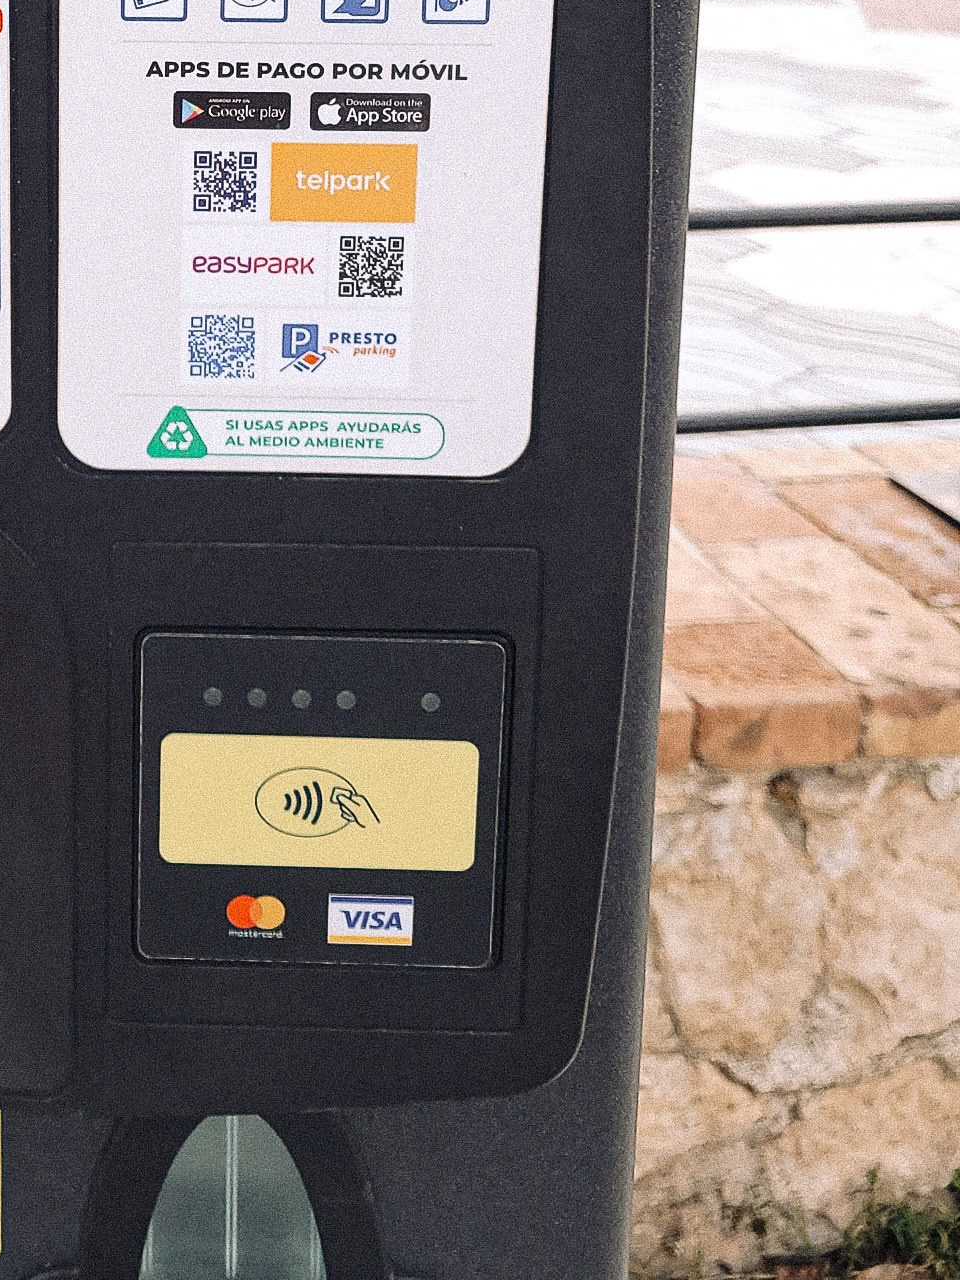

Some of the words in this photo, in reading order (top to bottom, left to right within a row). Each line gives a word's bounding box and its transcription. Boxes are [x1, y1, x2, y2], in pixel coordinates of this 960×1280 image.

[146, 61, 209, 77] APPS
[218, 62, 249, 78] DE
[258, 63, 324, 79] PAGO
[333, 63, 382, 79] POR
[391, 60, 467, 80] MÓVIL
[209, 102, 255, 121] Google
[260, 107, 285, 120] play
[346, 99, 392, 109] Download
[346, 108, 379, 125] App
[383, 108, 422, 122] Store
[297, 171, 390, 195] telpark
[292, 328, 310, 352] P
[330, 332, 397, 344] PRESTO
[353, 343, 396, 358] parking
[226, 420, 238, 430] SI
[244, 420, 283, 430] USAS
[288, 421, 328, 431] APPS
[337, 422, 421, 433] AYUDARÁS
[226, 436, 244, 446] AL
[250, 437, 300, 447] MEDIO
[305, 438, 383, 448] AMBIENTE
[343, 911, 402, 930] VISA
